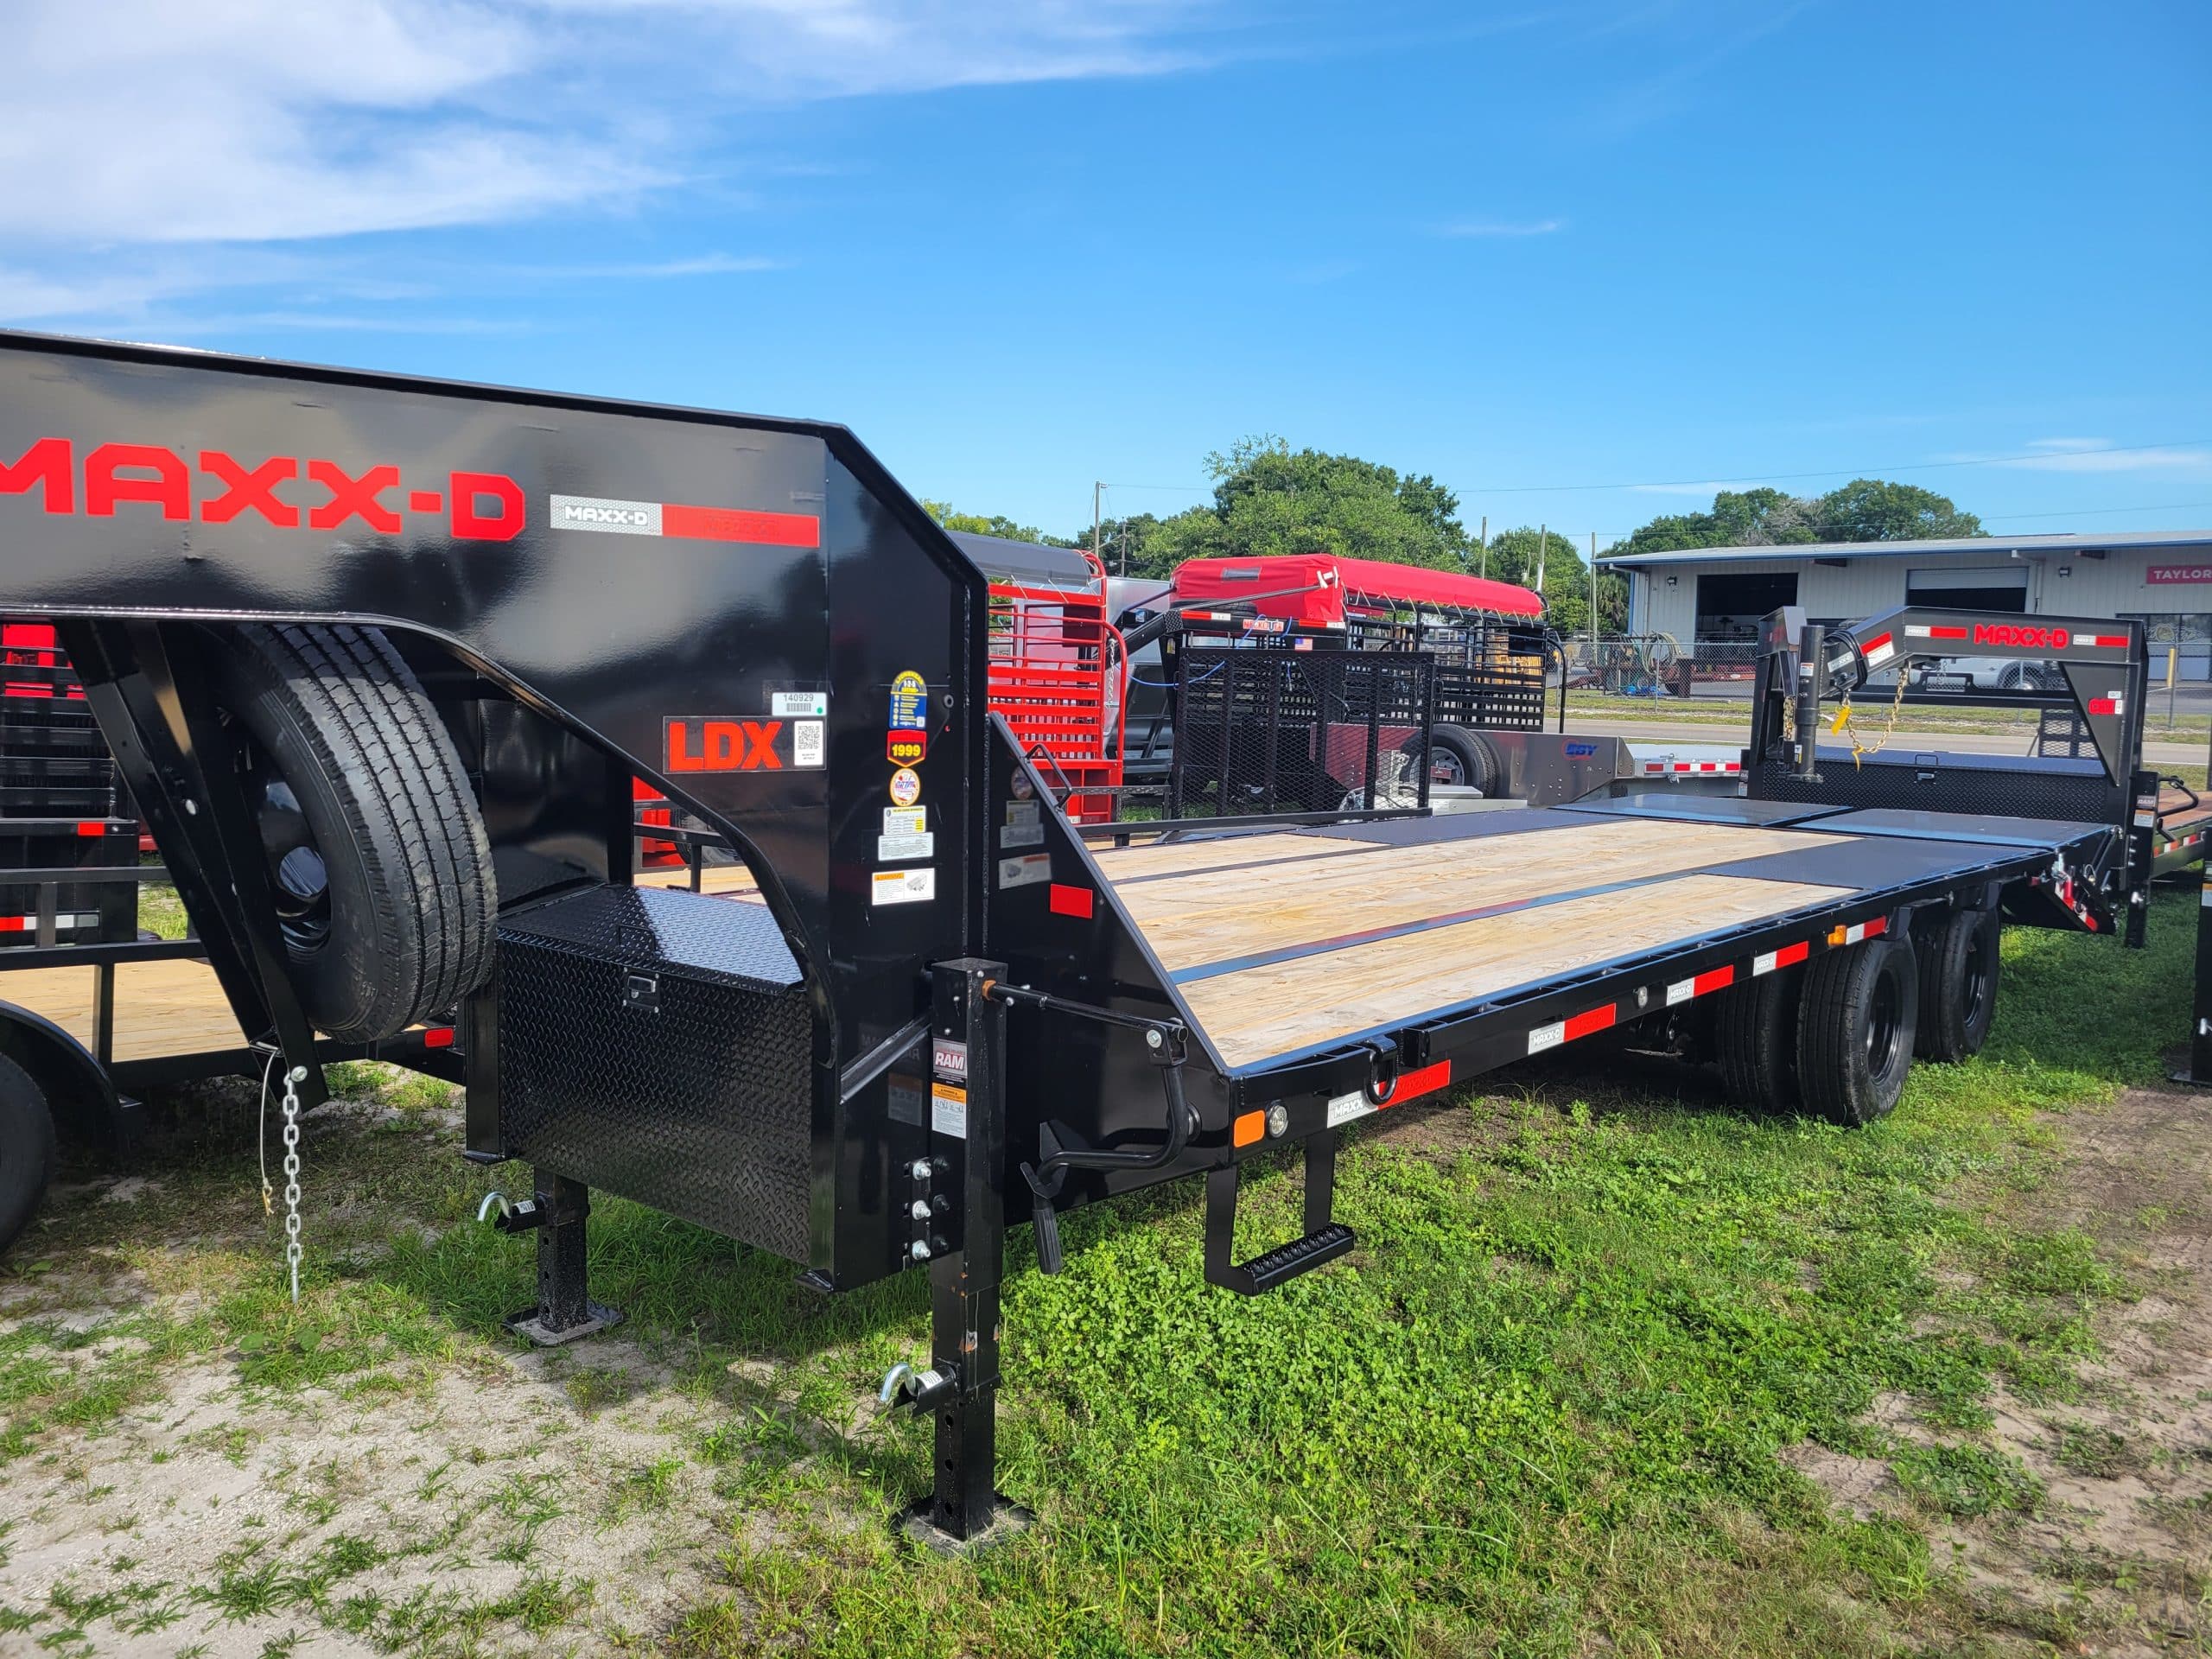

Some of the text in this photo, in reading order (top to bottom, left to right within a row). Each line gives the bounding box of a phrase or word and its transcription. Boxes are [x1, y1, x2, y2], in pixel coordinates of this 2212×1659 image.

[0, 437, 525, 541] MAXX-D
[564, 505, 648, 526] MAXX-D
[2153, 569, 2212, 580] TAYLOR
[1974, 624, 2069, 649] MAXX-D
[669, 721, 783, 771] LDX
[892, 744, 921, 757] 1999
[1533, 1028, 1560, 1046] MAXX-D
[935, 1052, 964, 1070] RAM
[1333, 1097, 1364, 1118] MAXX
